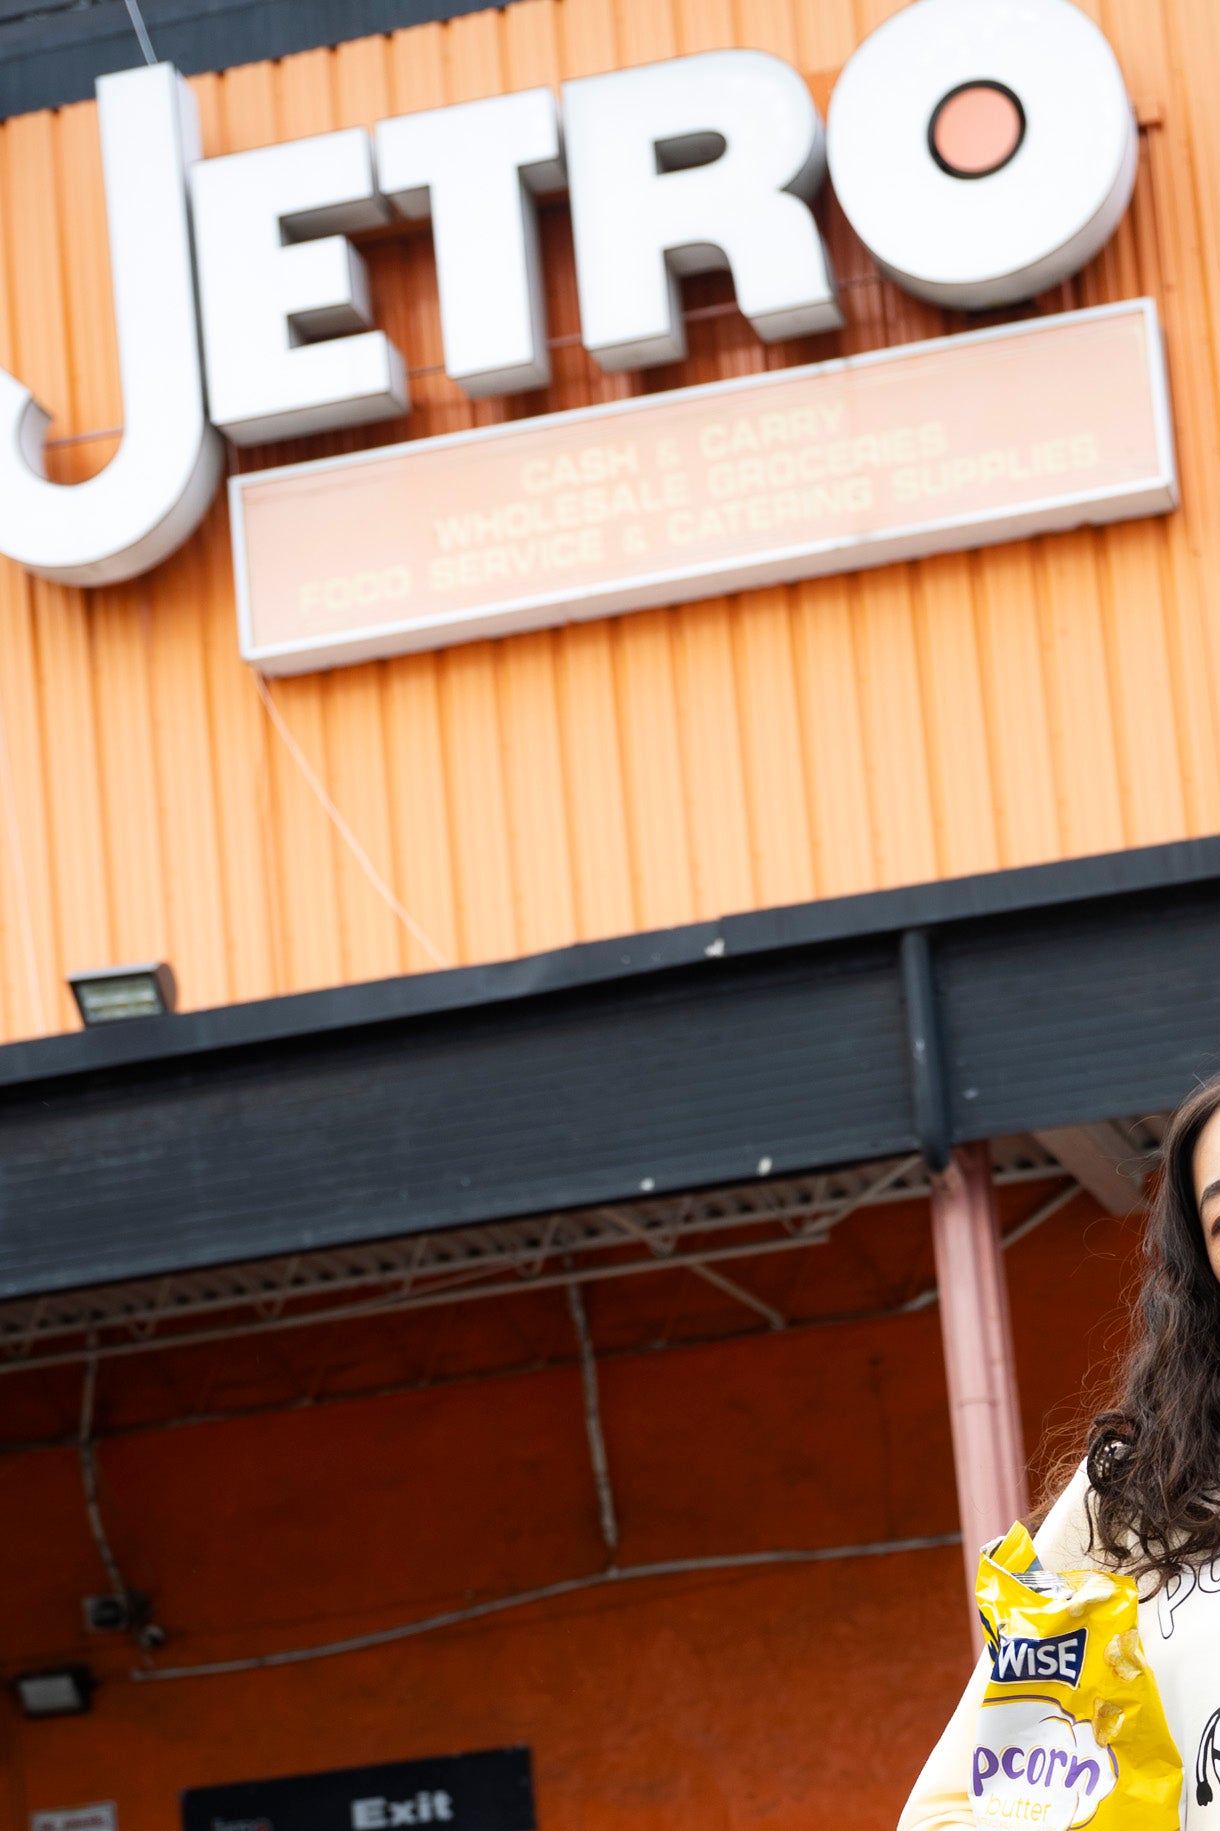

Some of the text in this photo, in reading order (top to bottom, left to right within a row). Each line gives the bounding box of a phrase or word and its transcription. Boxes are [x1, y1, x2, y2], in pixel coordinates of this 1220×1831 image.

[0, 0, 1140, 588] JETRO
[434, 420, 948, 550] WHOLESALE GROCERIES
[520, 445, 639, 495] CASH
[698, 398, 846, 461] CARRY
[297, 565, 412, 613] FOOD
[429, 526, 606, 591] SERVICE
[666, 474, 875, 545] CATERING
[890, 431, 1102, 507] SUPPLIES
[998, 1637, 1079, 1680] WISE
[351, 1789, 454, 1831] Exit
[985, 1792, 1053, 1823] butter
